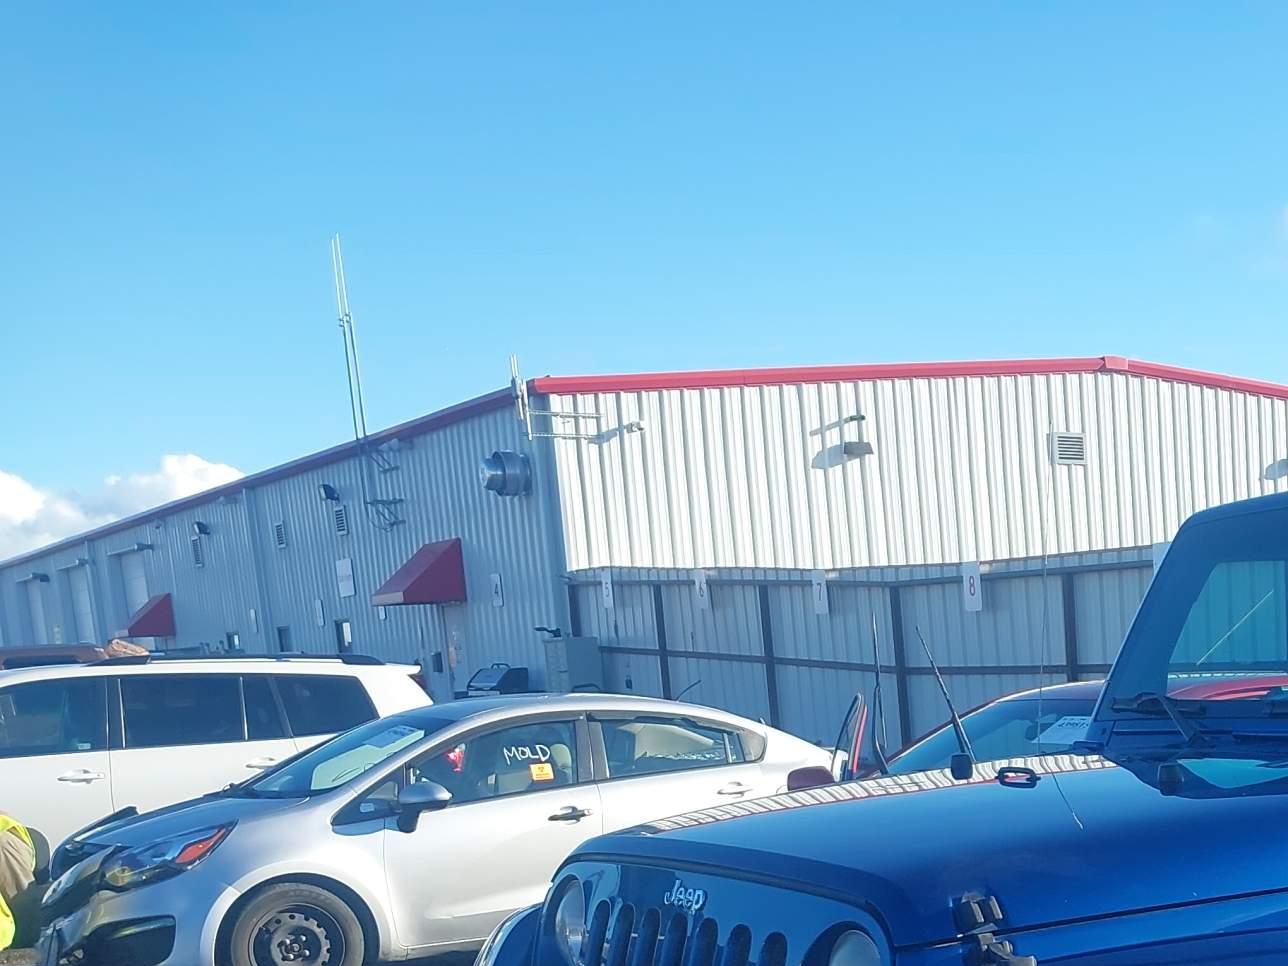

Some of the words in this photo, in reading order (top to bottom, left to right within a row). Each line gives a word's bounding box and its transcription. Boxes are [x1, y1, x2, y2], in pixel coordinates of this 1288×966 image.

[816, 582, 823, 601] 7
[968, 575, 976, 597] 8
[503, 744, 550, 766] MOLD
[664, 879, 704, 915] Jeep
